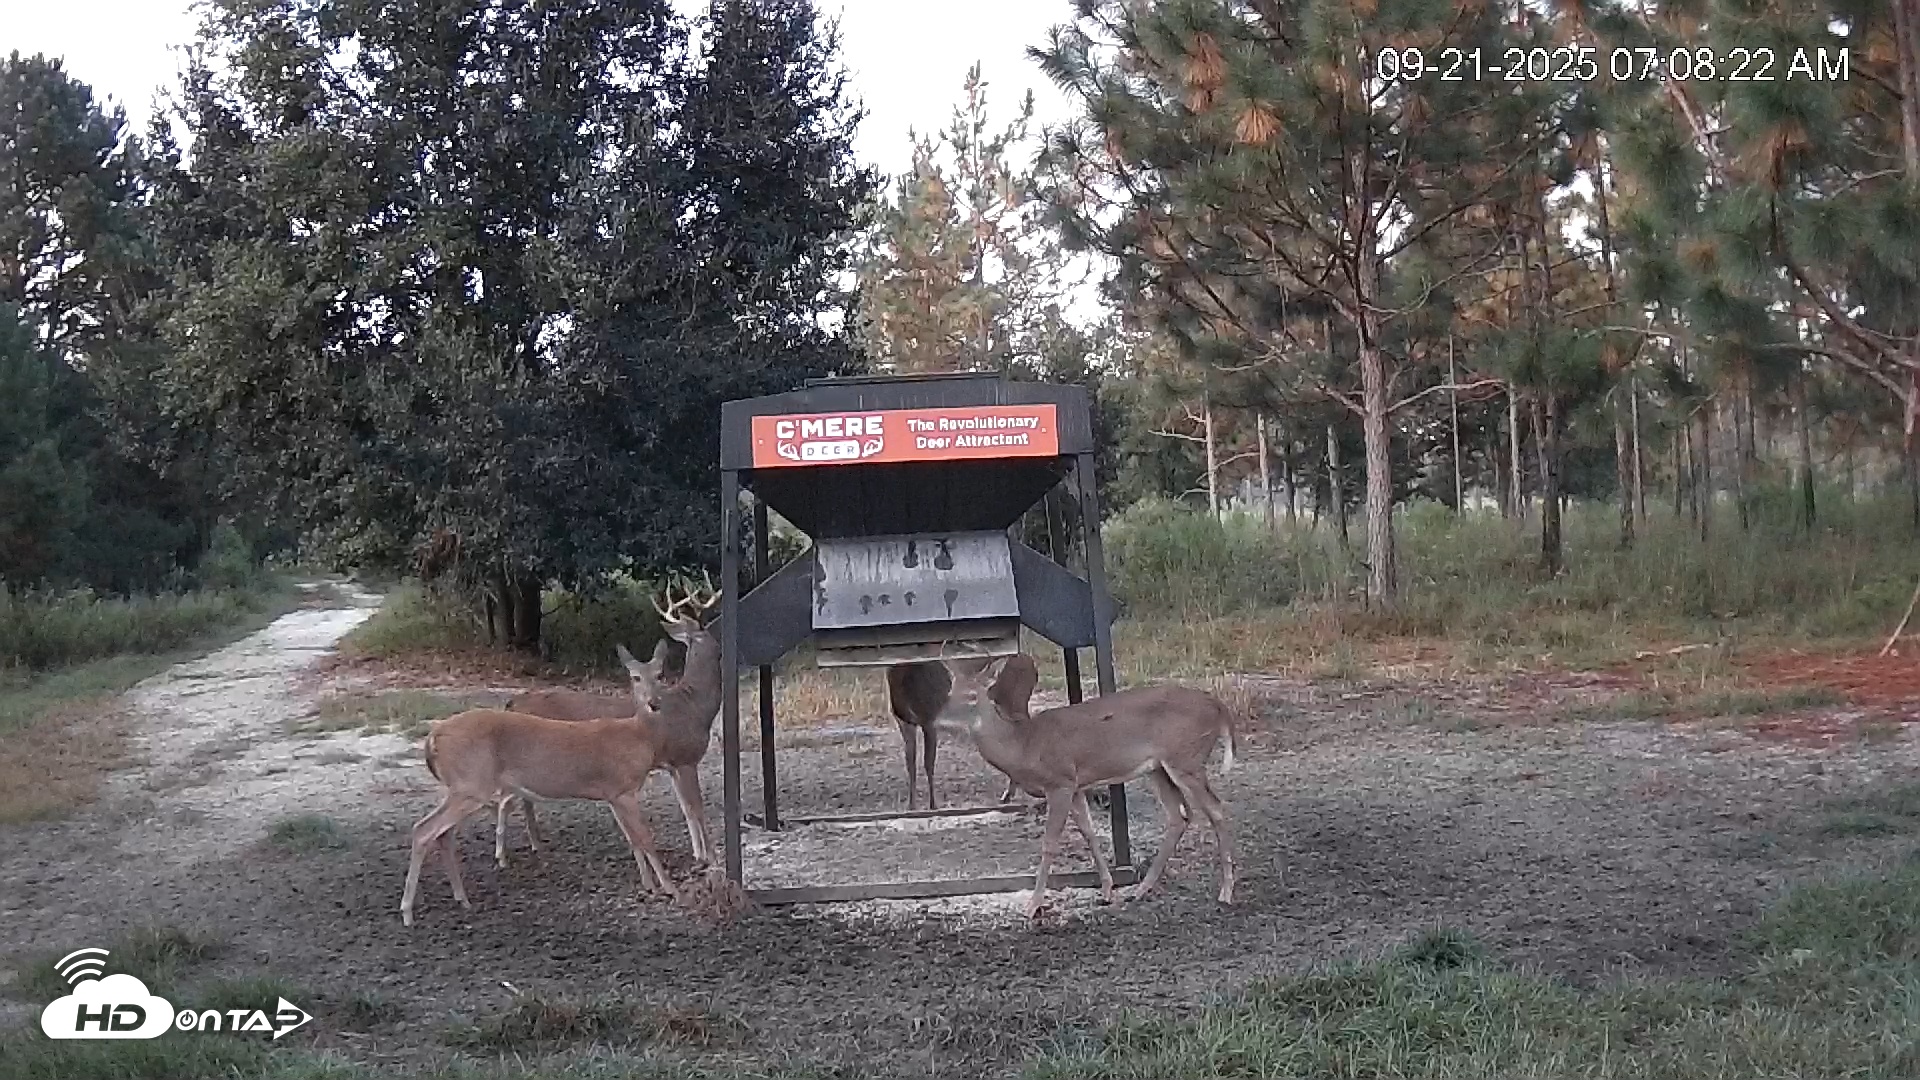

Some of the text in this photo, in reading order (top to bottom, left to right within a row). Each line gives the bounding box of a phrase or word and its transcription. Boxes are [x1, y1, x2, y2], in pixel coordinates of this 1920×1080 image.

[776, 416, 883, 439] C'MERE
[907, 416, 1039, 432] The Revolutionary
[916, 432, 1029, 449] Deer Attractant
[806, 445, 855, 457] DEER
